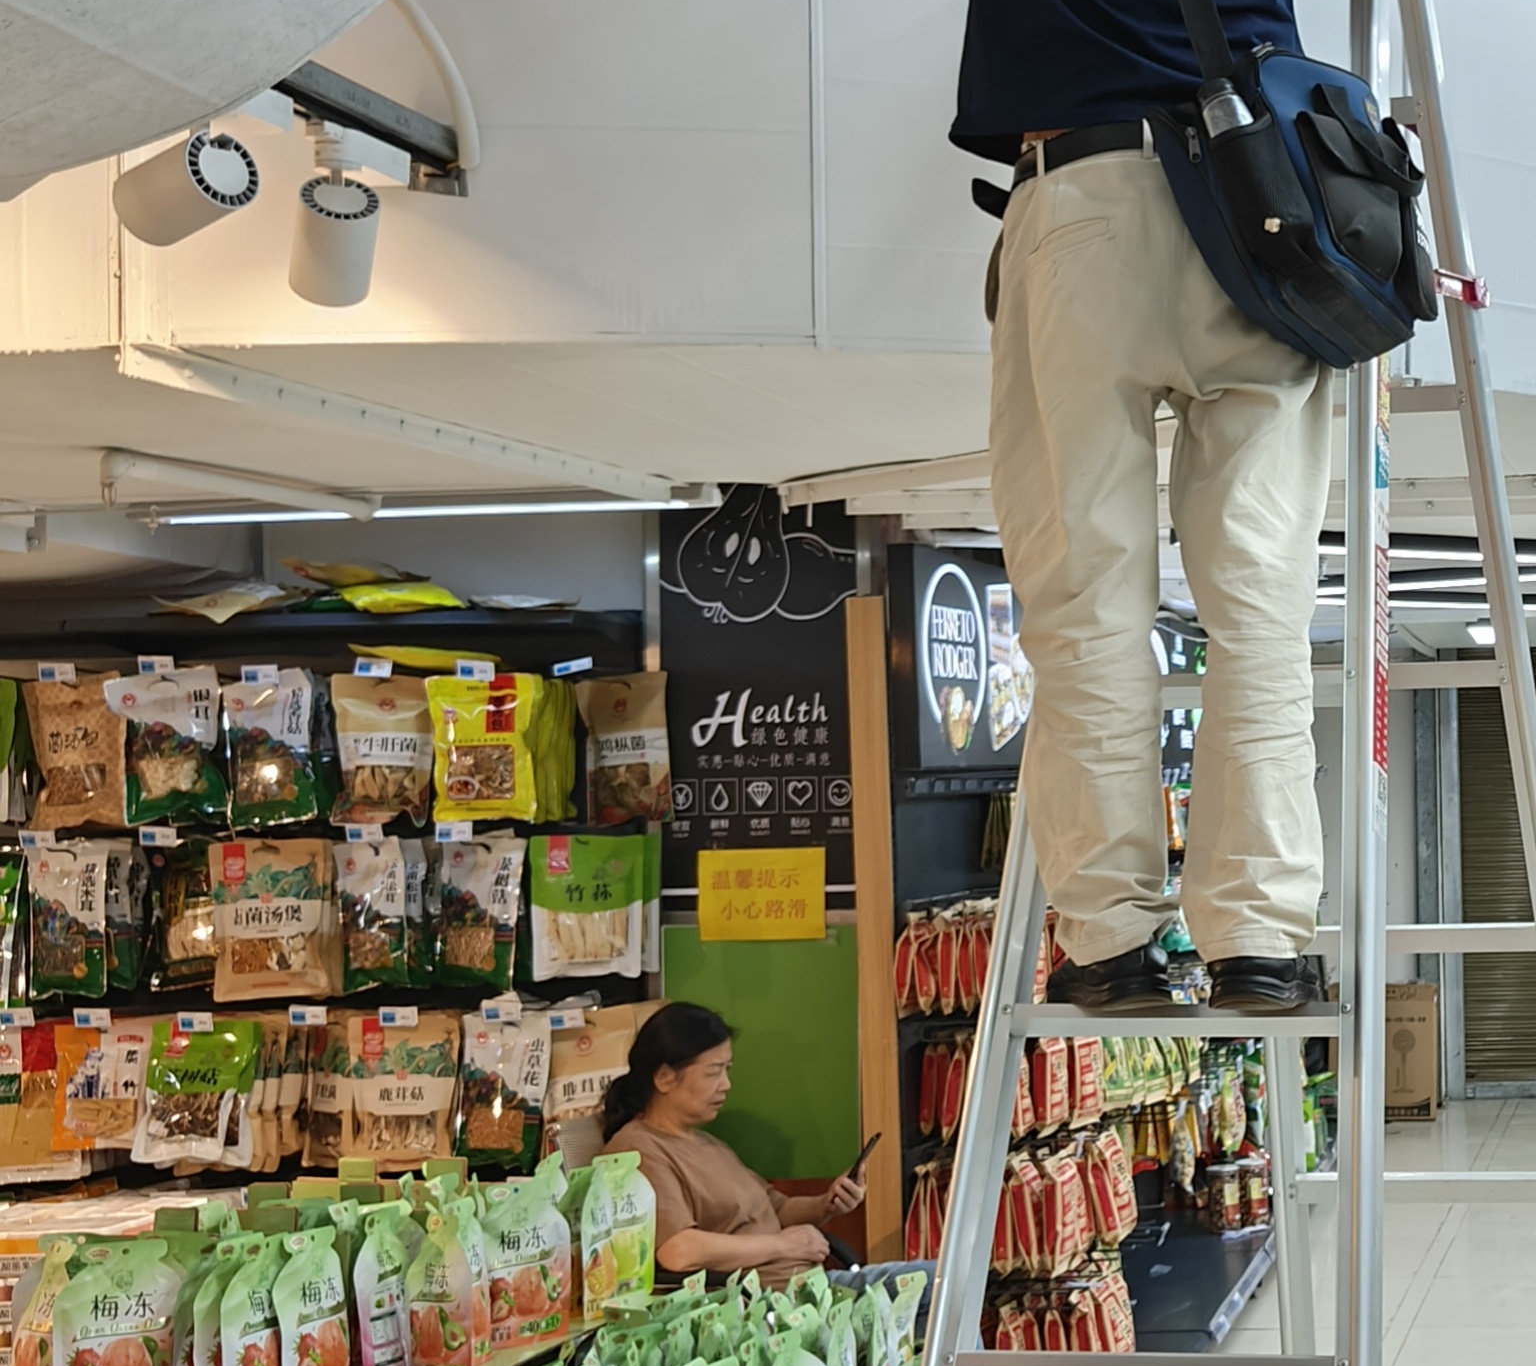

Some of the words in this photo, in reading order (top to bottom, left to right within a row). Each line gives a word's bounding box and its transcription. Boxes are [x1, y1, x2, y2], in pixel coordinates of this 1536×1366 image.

[691, 687, 829, 748] Health
[712, 867, 800, 890] 温馨提示
[721, 898, 808, 921] 小心路滑
[499, 1226, 547, 1254] 梅冻
[90, 1291, 157, 1322] 梅冻
[300, 1278, 341, 1308] 梅冻
